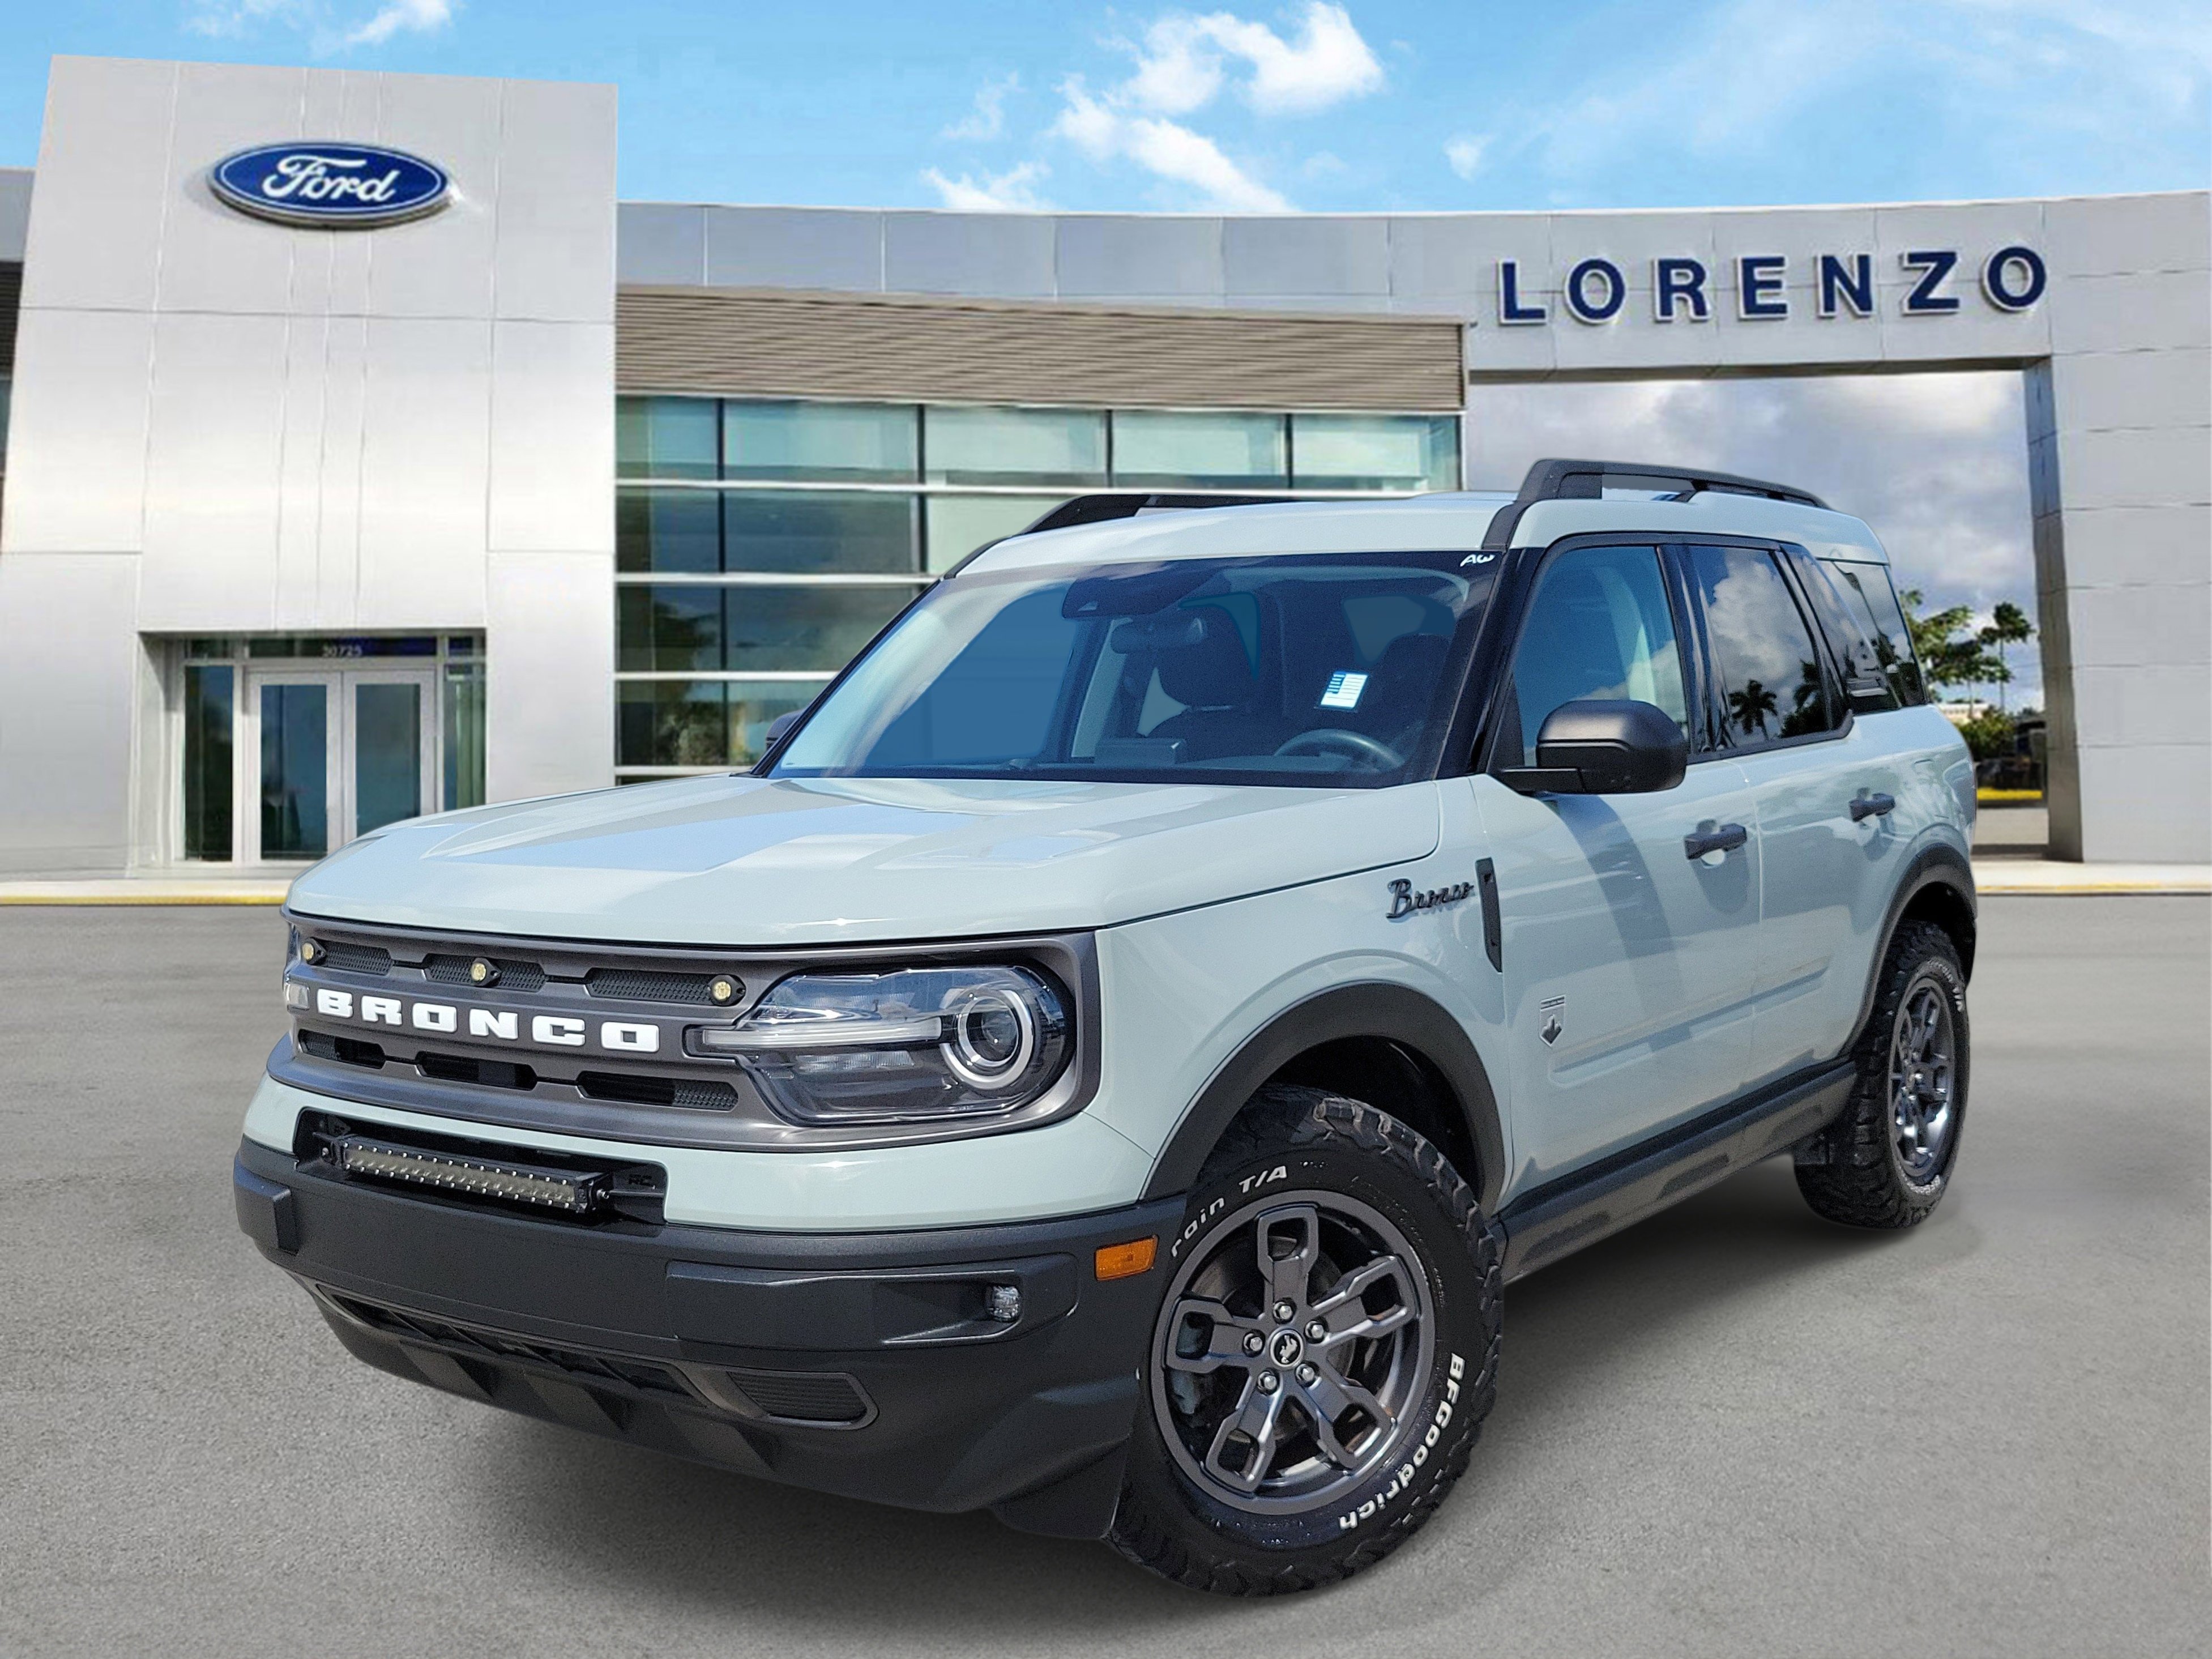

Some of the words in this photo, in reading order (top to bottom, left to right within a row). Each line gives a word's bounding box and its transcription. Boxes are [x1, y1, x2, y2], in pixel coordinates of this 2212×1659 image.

[262, 155, 400, 202] Ford
[1499, 246, 2047, 323] LORENZO
[1386, 878, 1474, 919] Bronco
[316, 988, 660, 1053] BRONCO
[1171, 1197, 1225, 1257] rain
[1239, 1165, 1287, 1193] T/A
[1339, 1353, 1465, 1529] BFGoodrich
